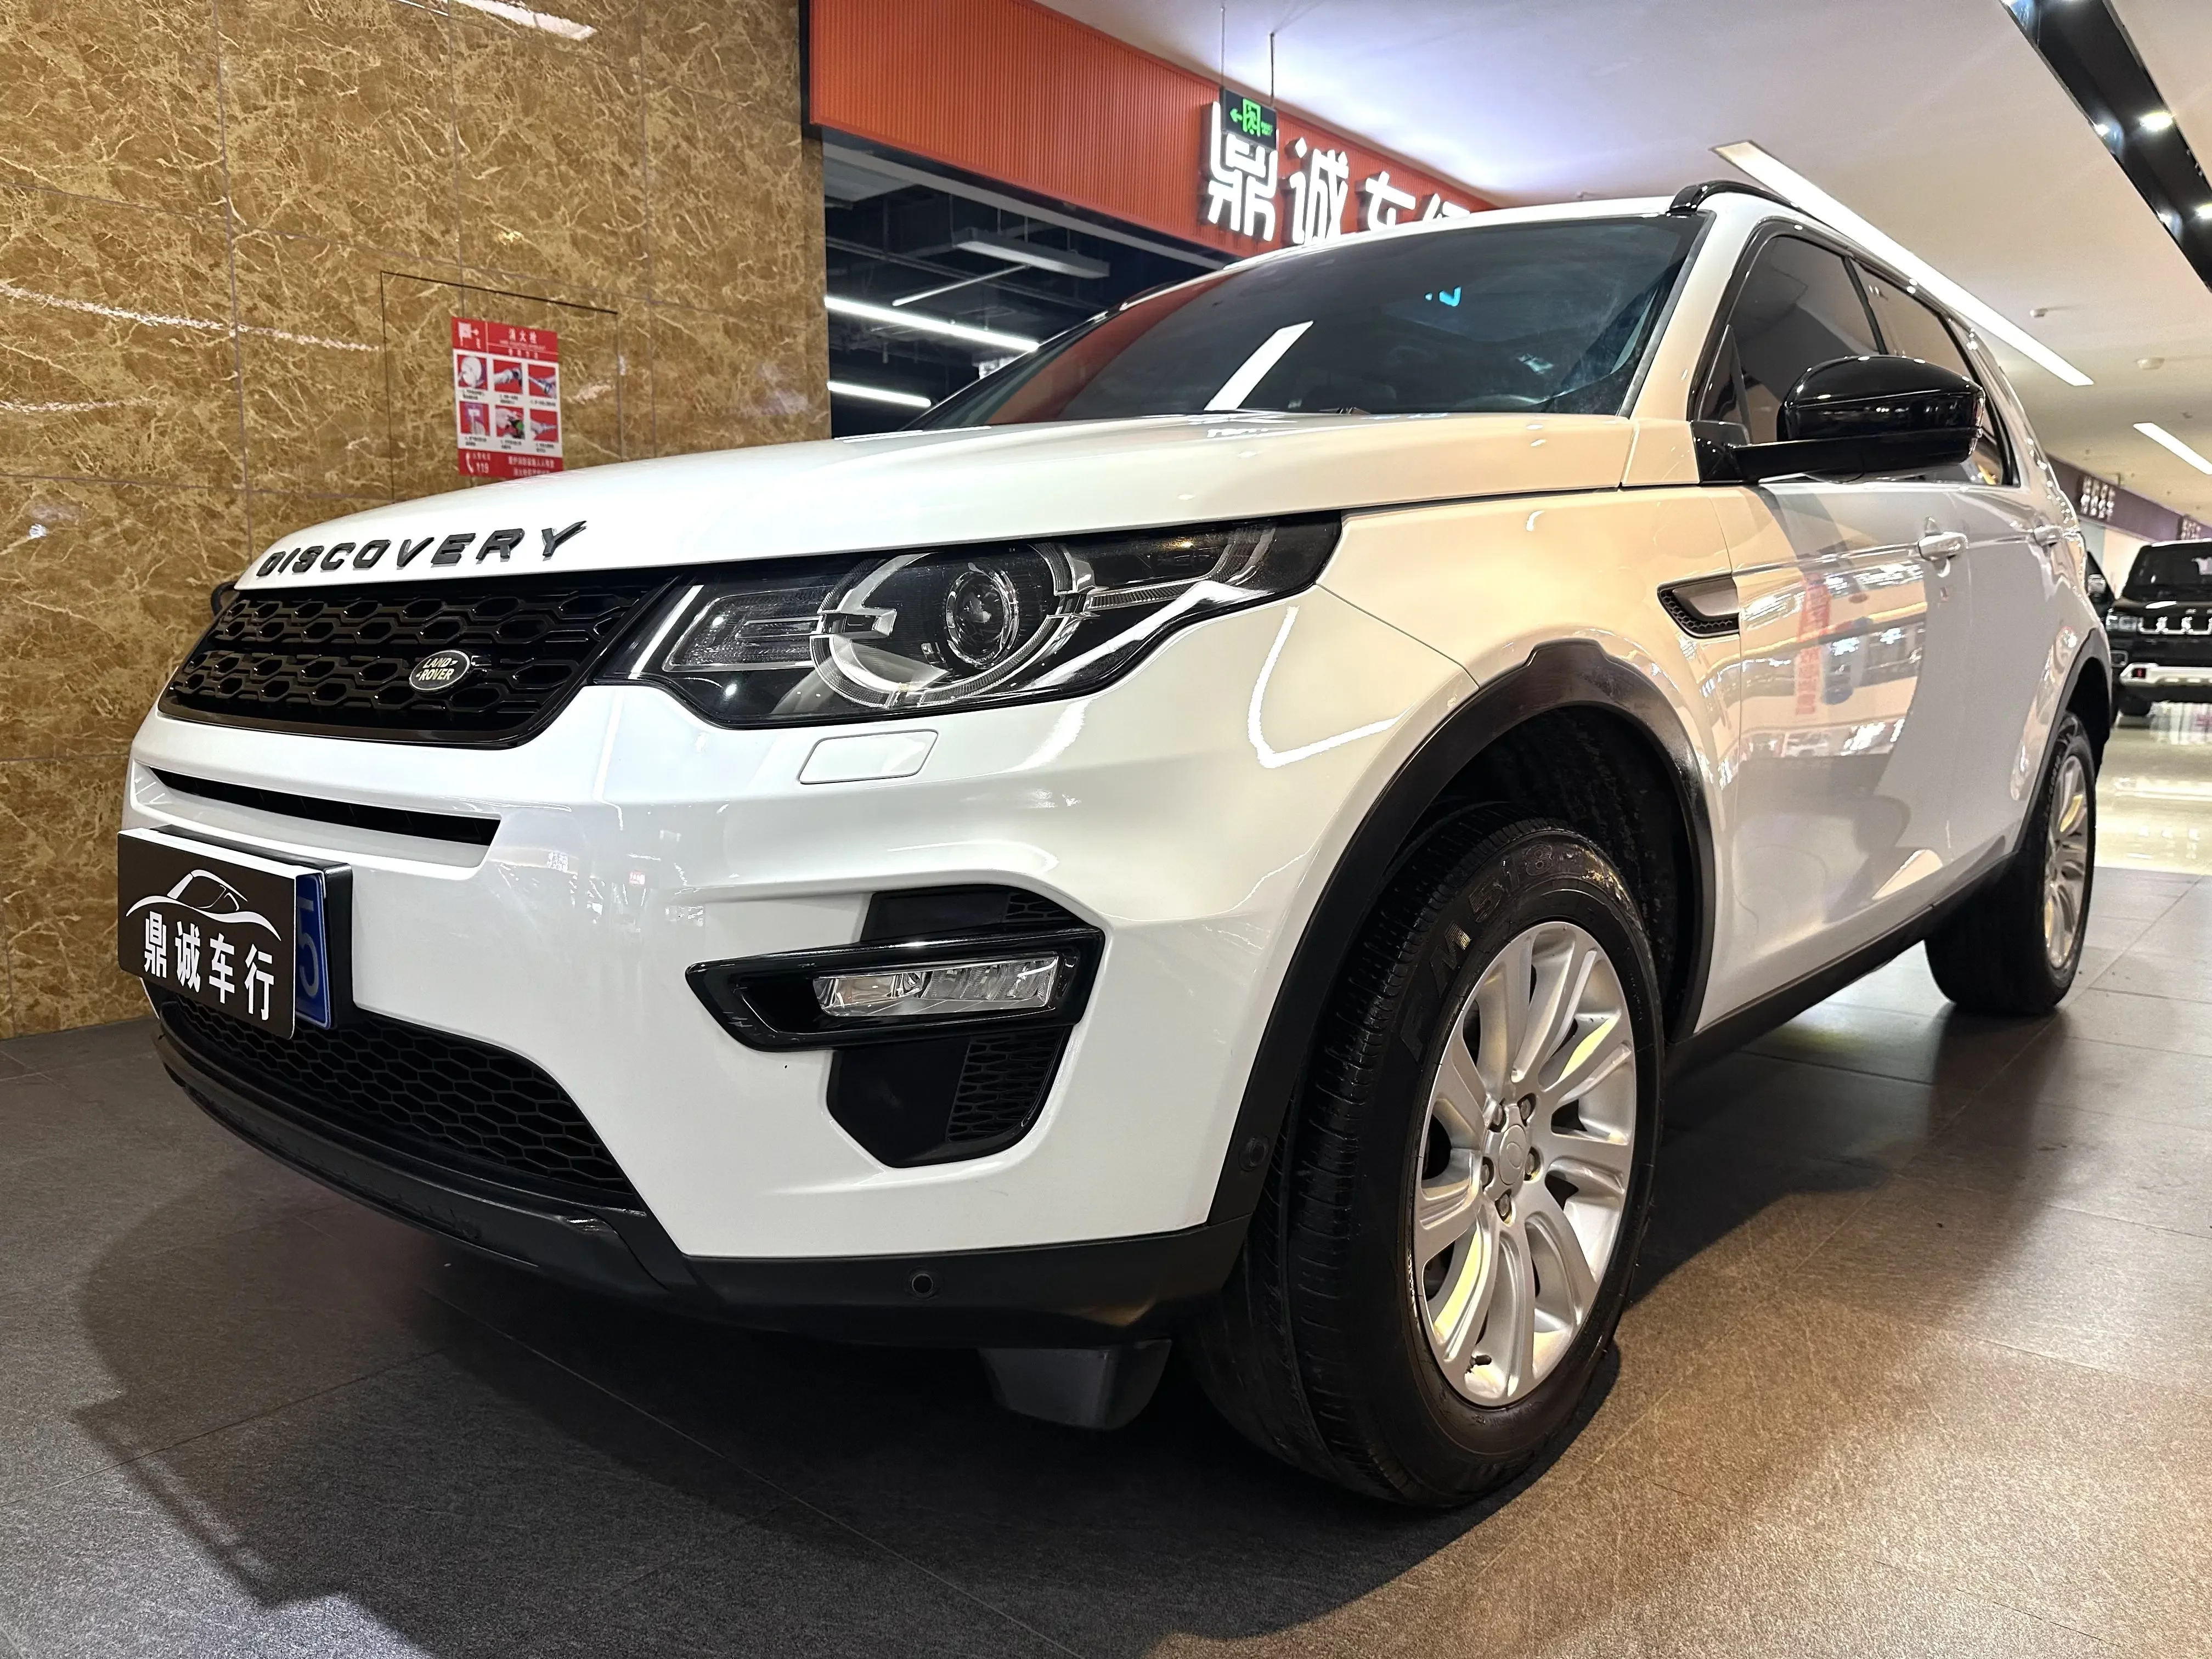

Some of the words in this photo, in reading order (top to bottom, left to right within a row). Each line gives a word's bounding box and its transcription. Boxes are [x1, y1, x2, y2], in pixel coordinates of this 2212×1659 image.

[256, 520, 588, 578] DISCOVERY
[418, 668, 455, 681] ROVER
[422, 657, 453, 669] LAND
[144, 911, 275, 1021] 鼎诚车行
